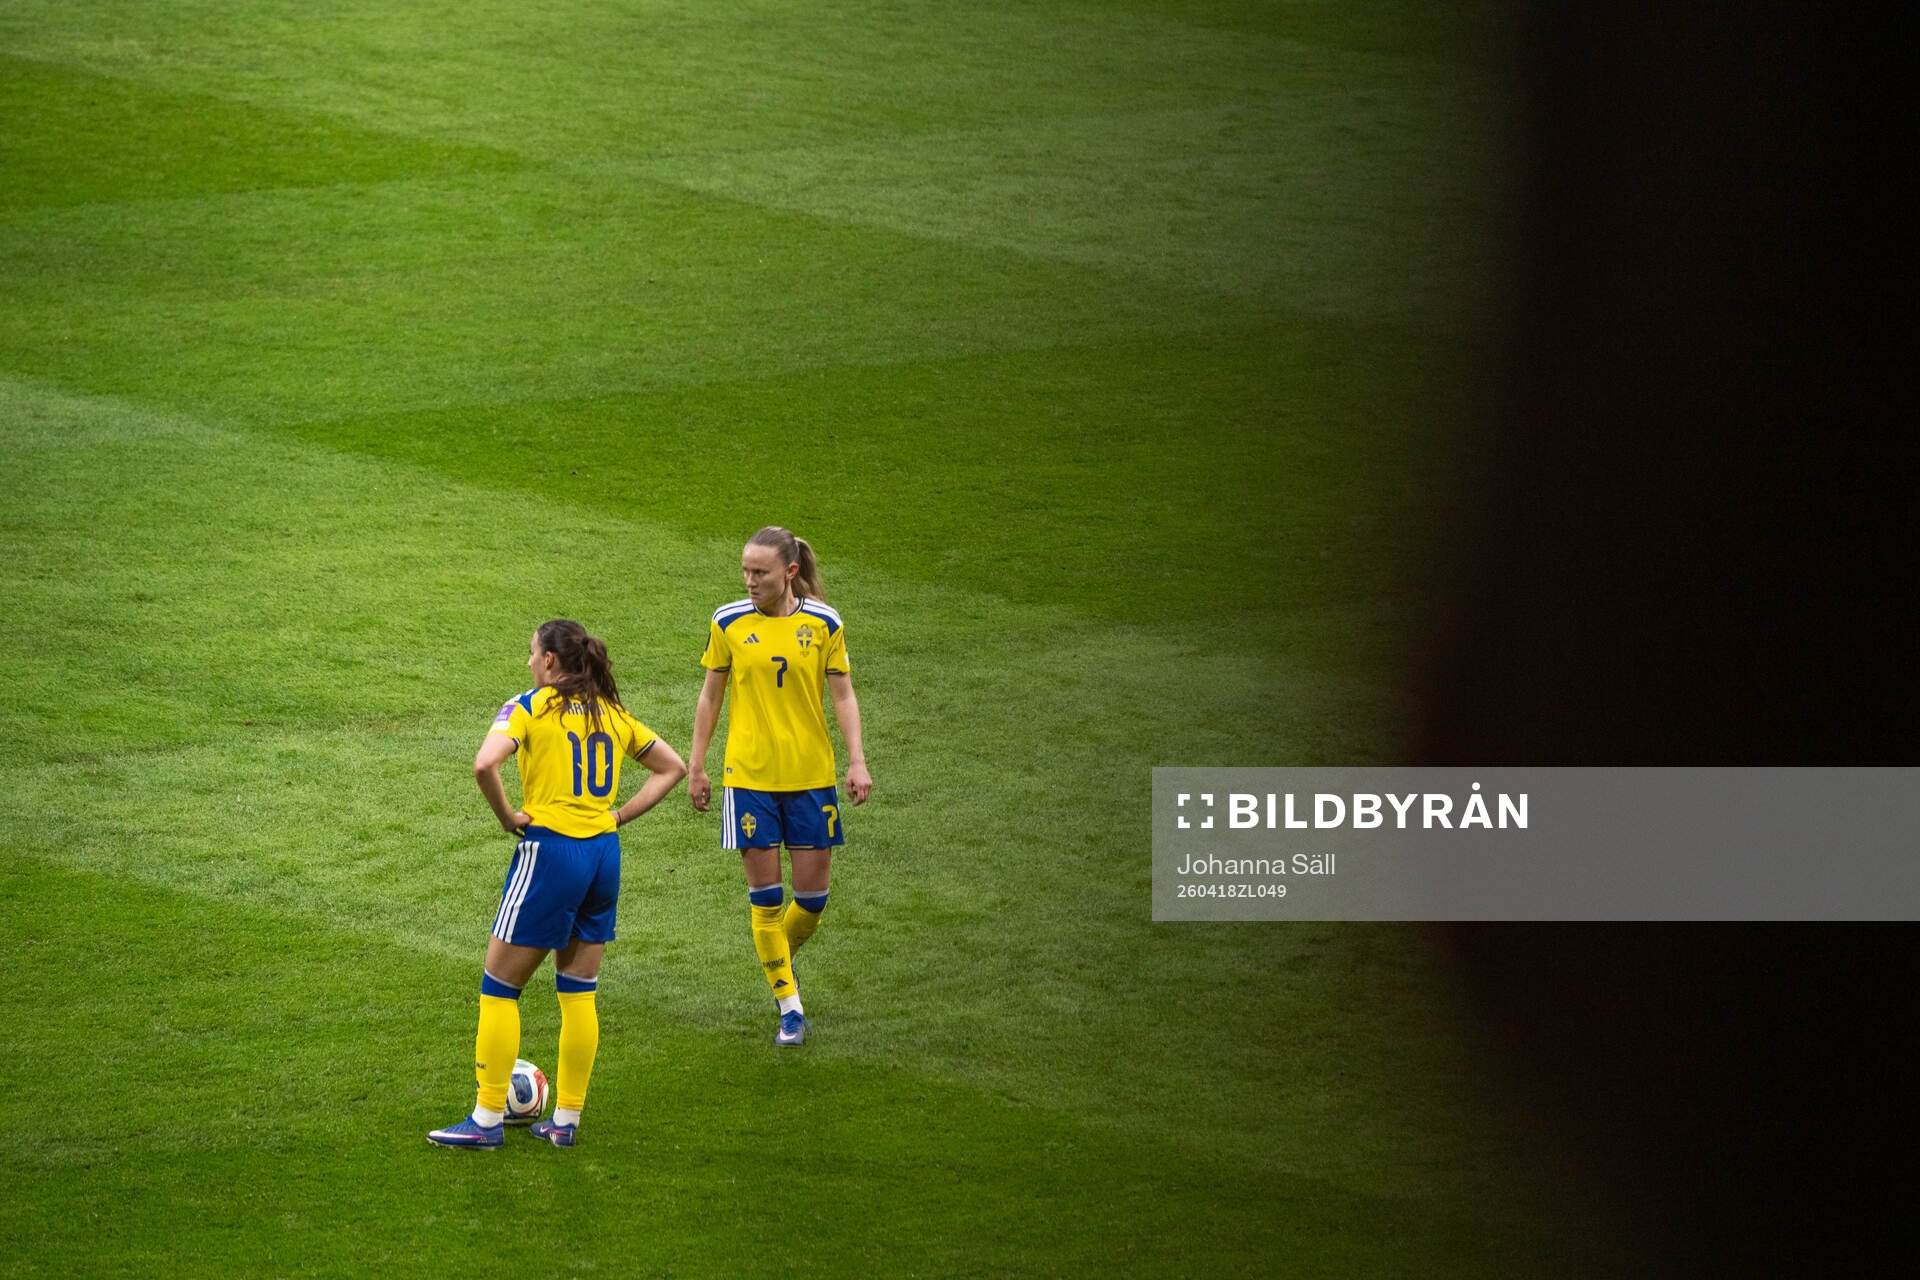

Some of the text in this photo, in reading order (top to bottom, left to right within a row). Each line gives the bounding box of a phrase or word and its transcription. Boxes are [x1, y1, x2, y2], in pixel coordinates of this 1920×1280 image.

[771, 656, 788, 688] 7
[567, 731, 614, 797] 10
[822, 805, 838, 838] 7
